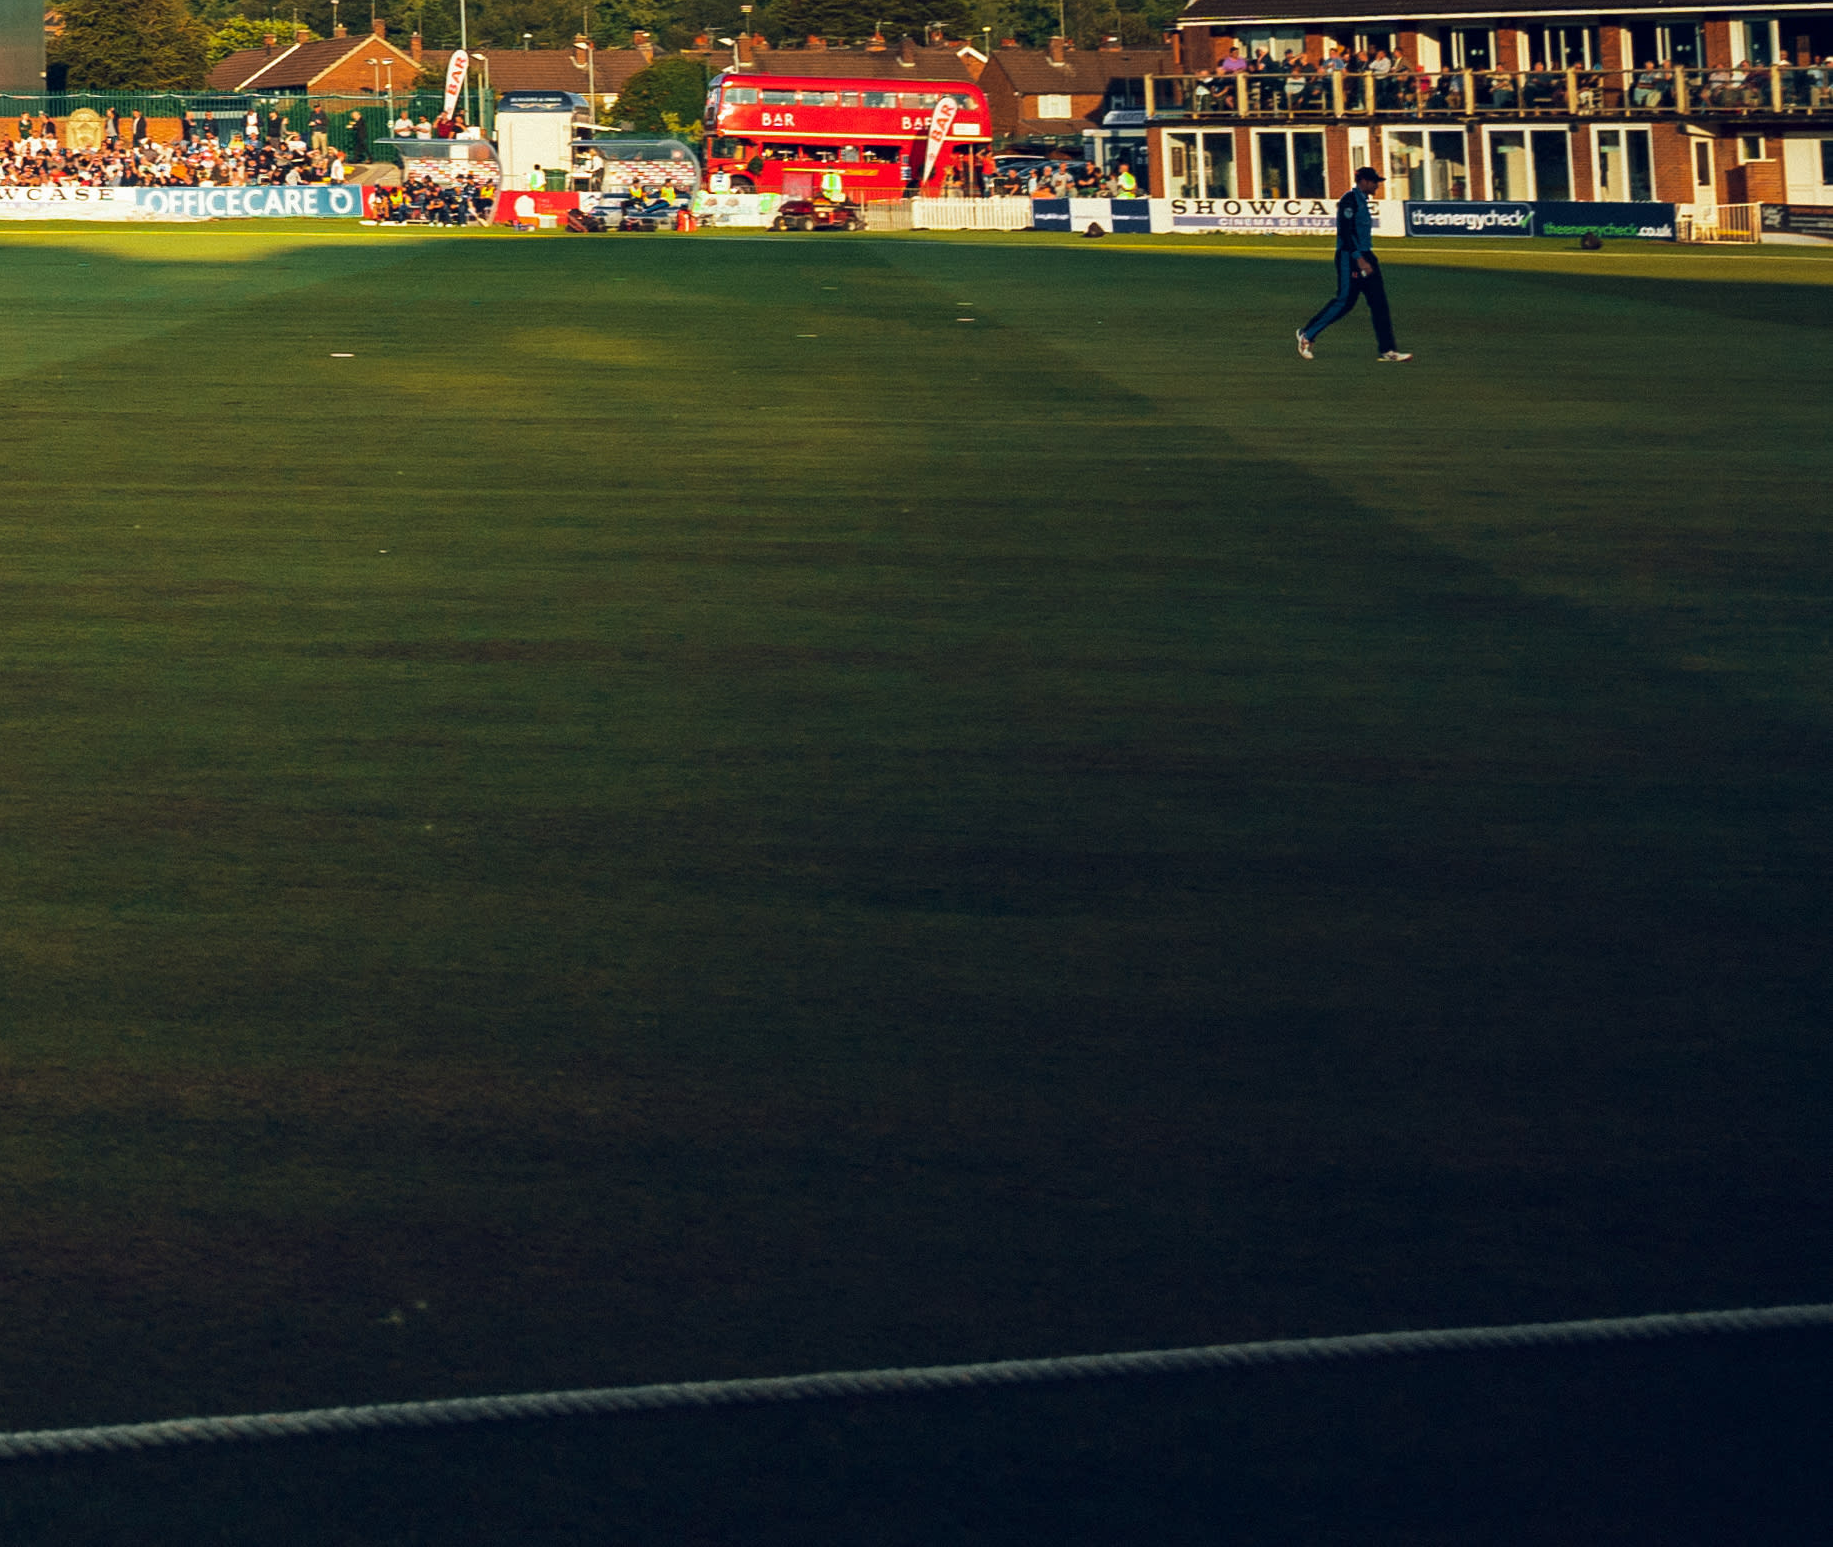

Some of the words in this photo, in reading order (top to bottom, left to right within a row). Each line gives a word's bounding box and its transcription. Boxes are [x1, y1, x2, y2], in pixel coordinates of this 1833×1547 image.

[447, 56, 467, 96] BAR
[761, 113, 795, 126] BAR
[933, 104, 955, 143] BAR
[144, 188, 320, 215] OFFICECARE
[1172, 200, 1380, 216] SHOWCAE
[1218, 218, 1274, 226] CINEMA
[1282, 218, 1300, 226] DE
[1412, 209, 1524, 230] theenergycheck
